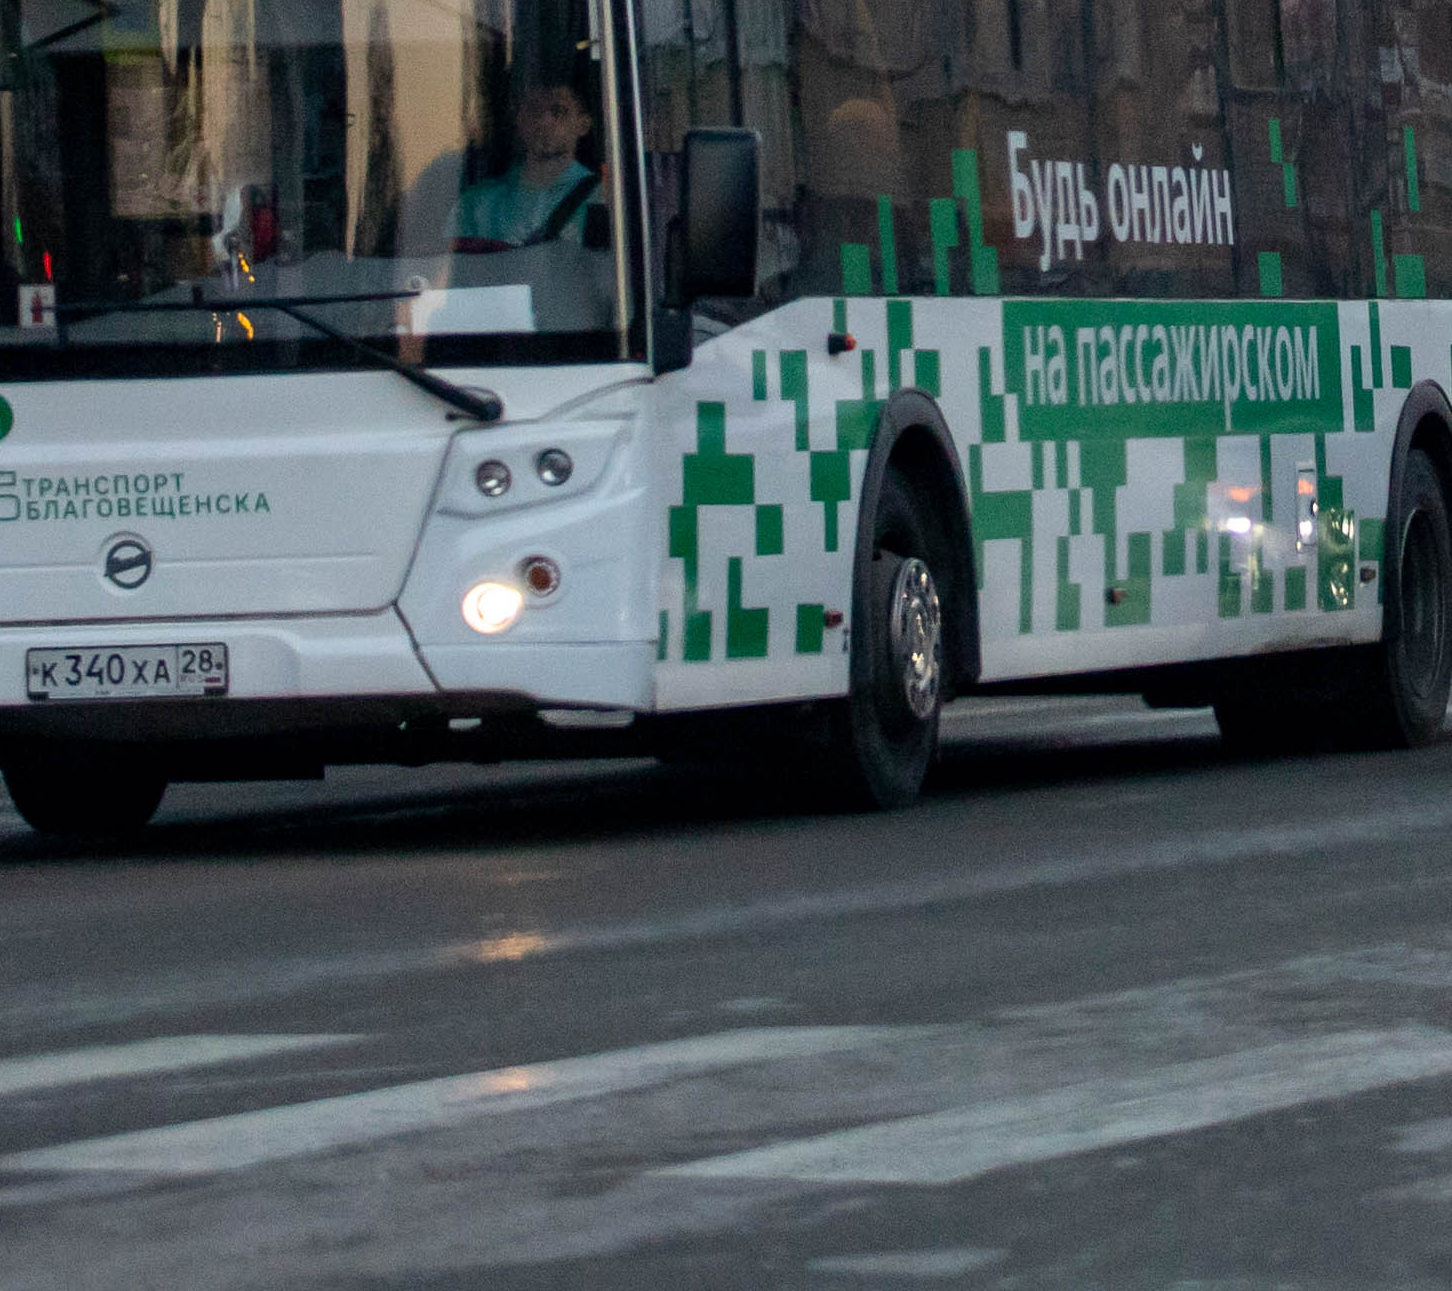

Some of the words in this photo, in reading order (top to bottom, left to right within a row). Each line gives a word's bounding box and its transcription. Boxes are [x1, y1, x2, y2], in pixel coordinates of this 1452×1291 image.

[1007, 130, 1098, 272] Будь
[1108, 142, 1235, 246] онлайн
[1023, 324, 1069, 405] на
[1077, 324, 1321, 432] пассажирском
[21, 472, 186, 499] ТРАНСПОРТ
[25, 492, 271, 521] БЛАГОВЕЩЕНСКА
[182, 649, 214, 674] 28
